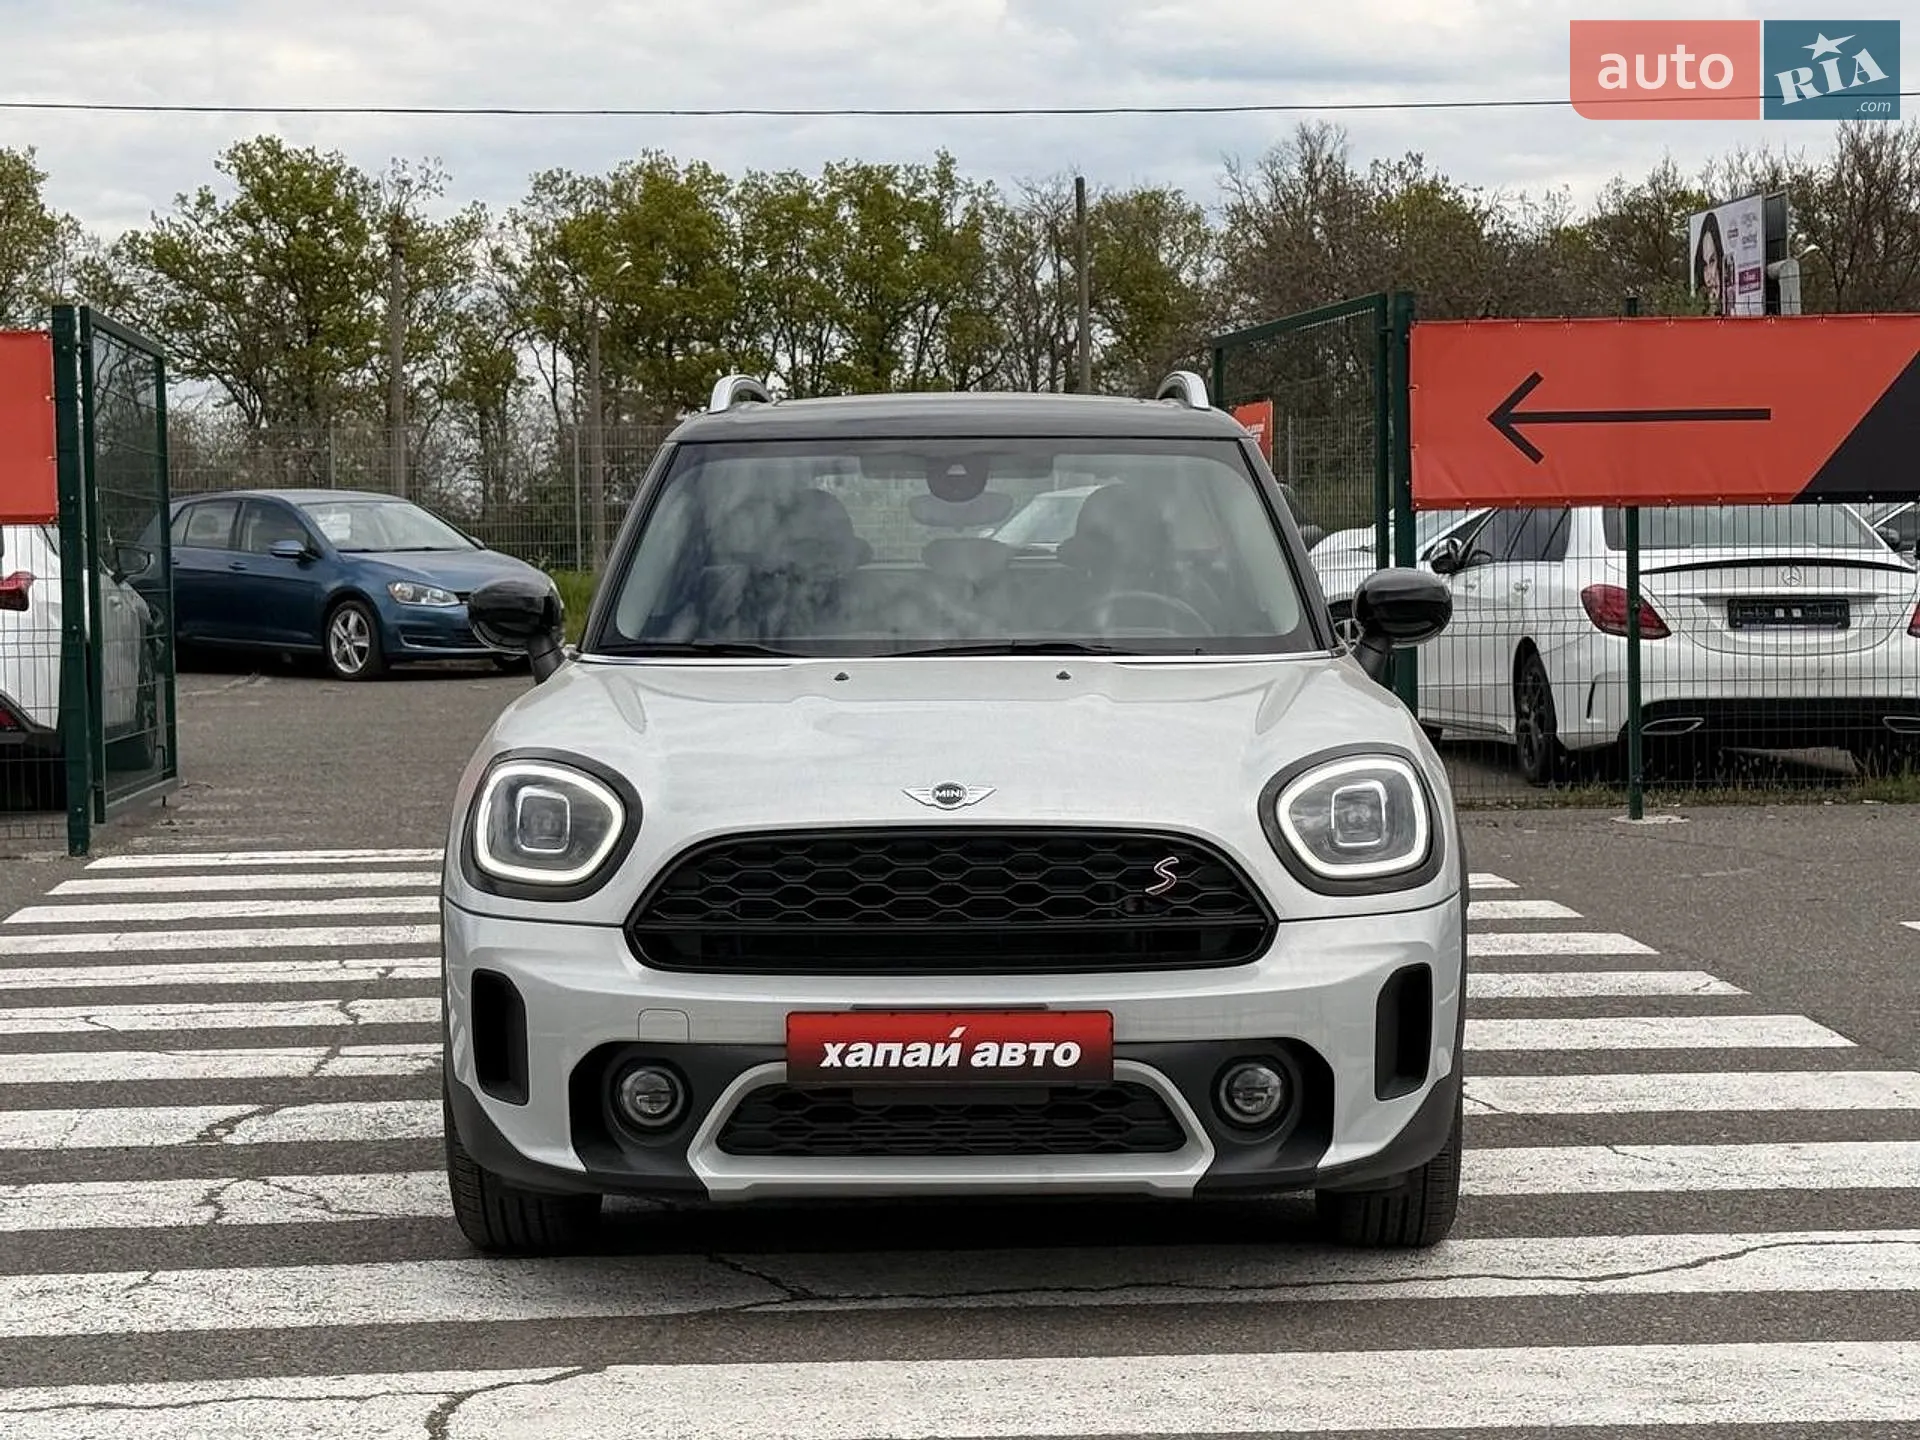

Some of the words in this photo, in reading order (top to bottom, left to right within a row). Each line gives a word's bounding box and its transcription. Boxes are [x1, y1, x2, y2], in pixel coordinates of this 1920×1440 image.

[935, 789, 963, 798] MINI
[1145, 856, 1180, 896] S
[820, 1026, 969, 1068] хапай
[970, 1041, 1081, 1068] авто
